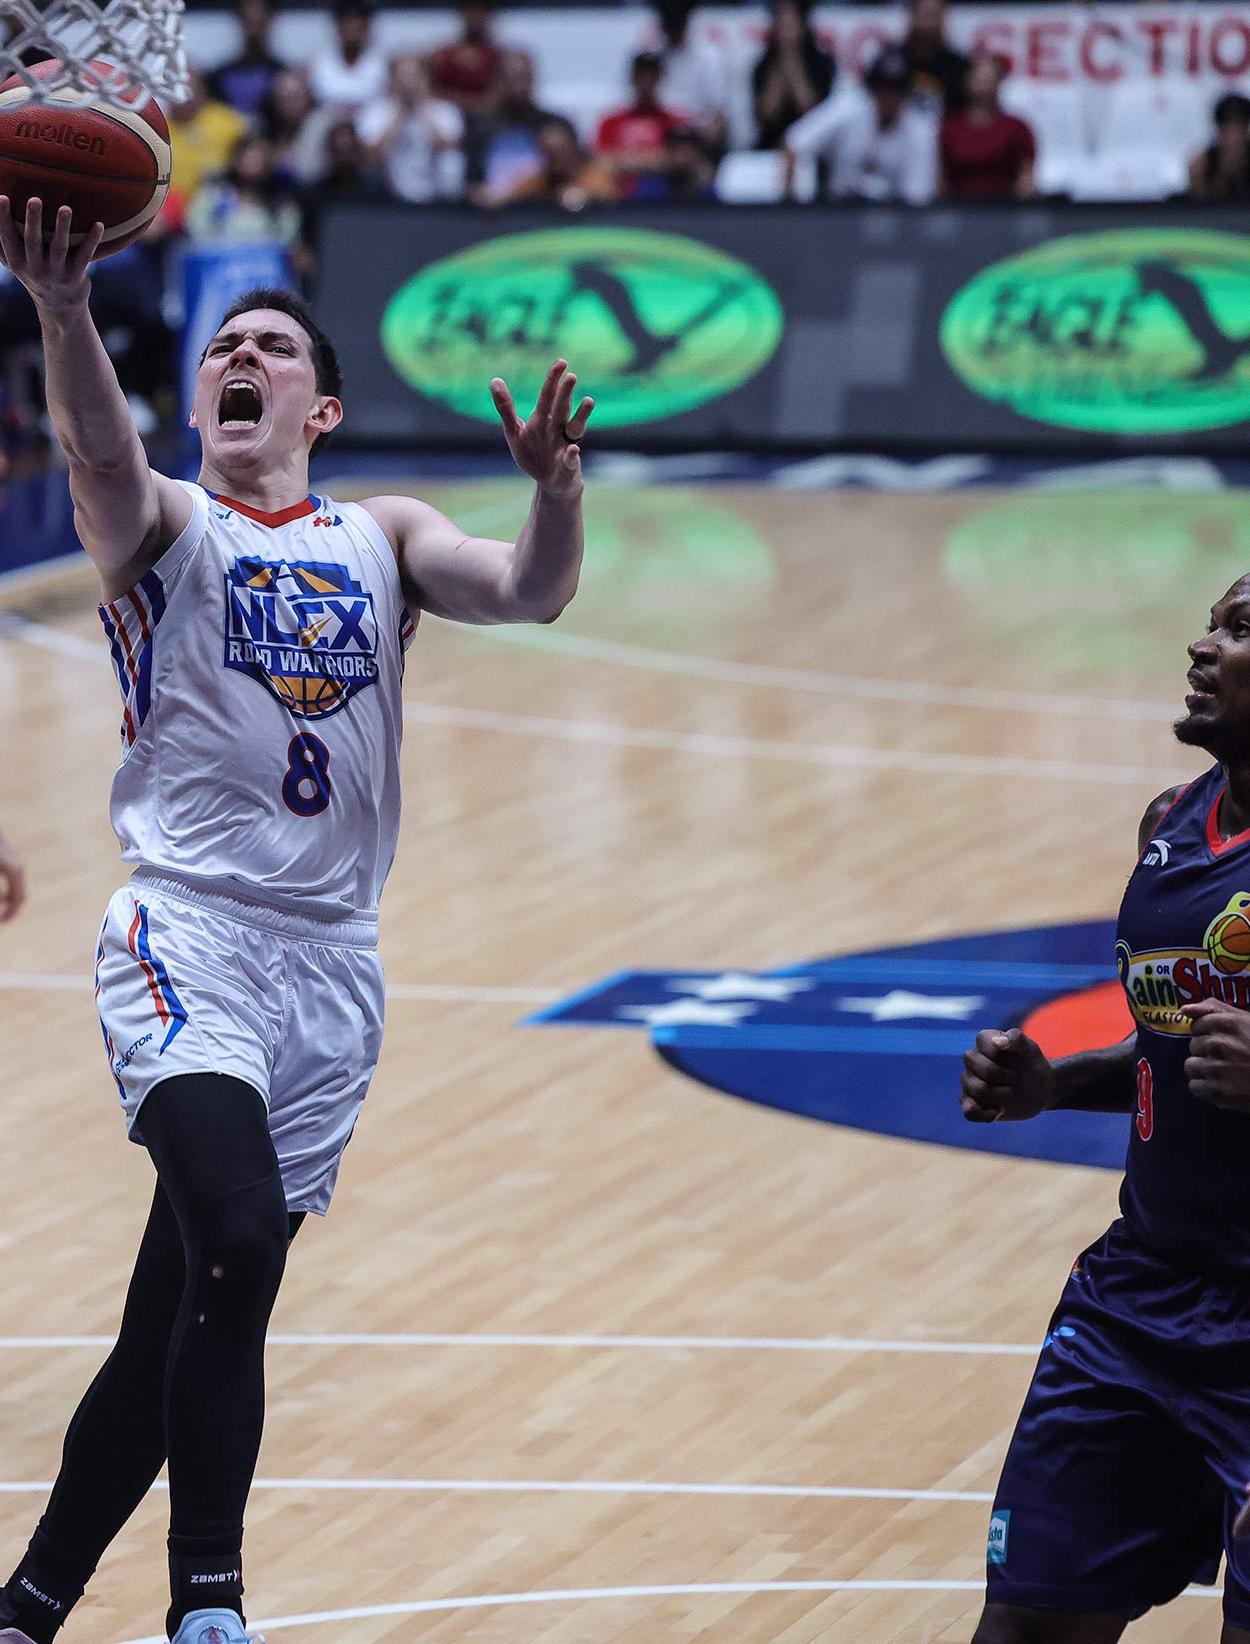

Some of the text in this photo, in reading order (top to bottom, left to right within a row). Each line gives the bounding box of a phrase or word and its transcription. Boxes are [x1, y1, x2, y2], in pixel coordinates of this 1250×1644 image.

[14, 120, 106, 156] molten
[278, 650, 379, 677] WARRIORS
[282, 731, 331, 817] 8
[1156, 964, 1171, 975] OR
